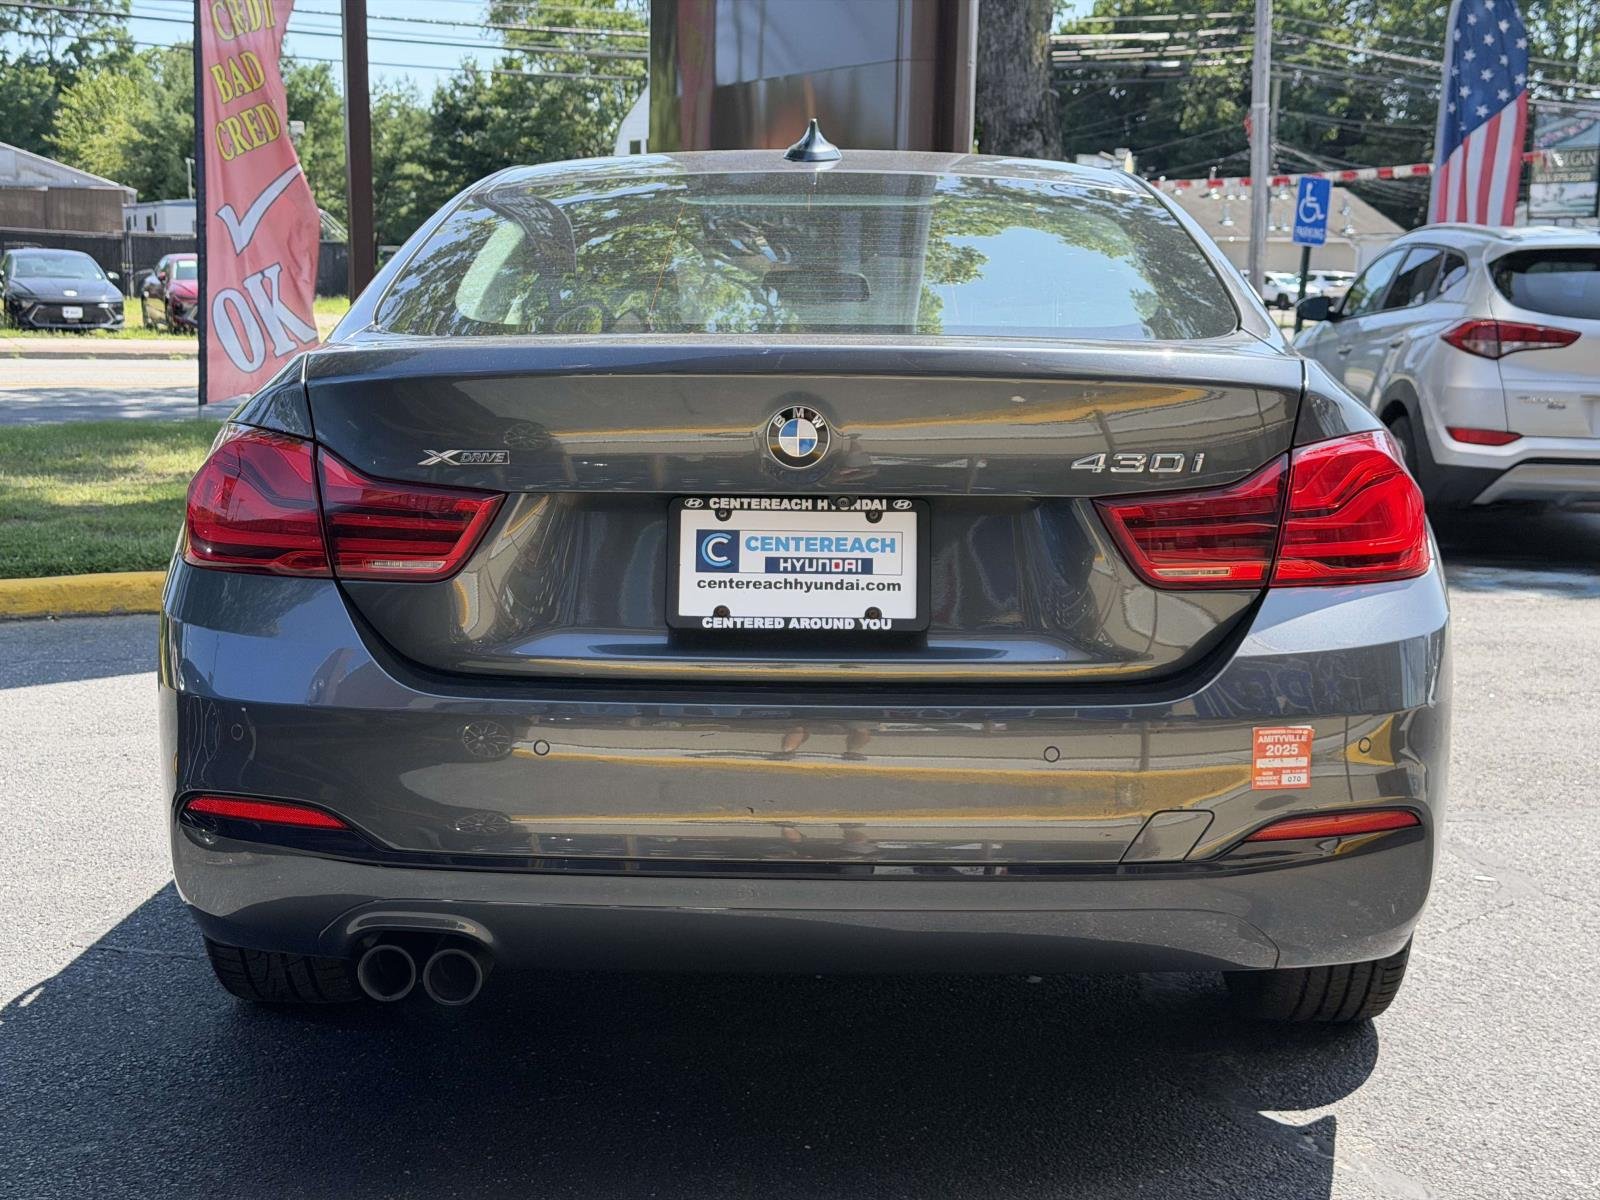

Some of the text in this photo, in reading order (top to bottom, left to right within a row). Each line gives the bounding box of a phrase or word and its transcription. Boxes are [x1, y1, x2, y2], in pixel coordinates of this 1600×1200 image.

[210, 51, 266, 104] BAD
[212, 262, 318, 374] OK
[773, 407, 825, 428] BMW
[1070, 453, 1205, 473] 430i
[709, 498, 887, 511] CENTEREACH HNDAI
[745, 536, 896, 554] CENTEREACH
[779, 558, 862, 573] HYUNDAI
[696, 577, 902, 593] centereachhyundai.com
[702, 617, 892, 630] CENTERED AROUND YOU
[1258, 735, 1307, 743] AMITYVILLE
[1265, 744, 1298, 755] 2025
